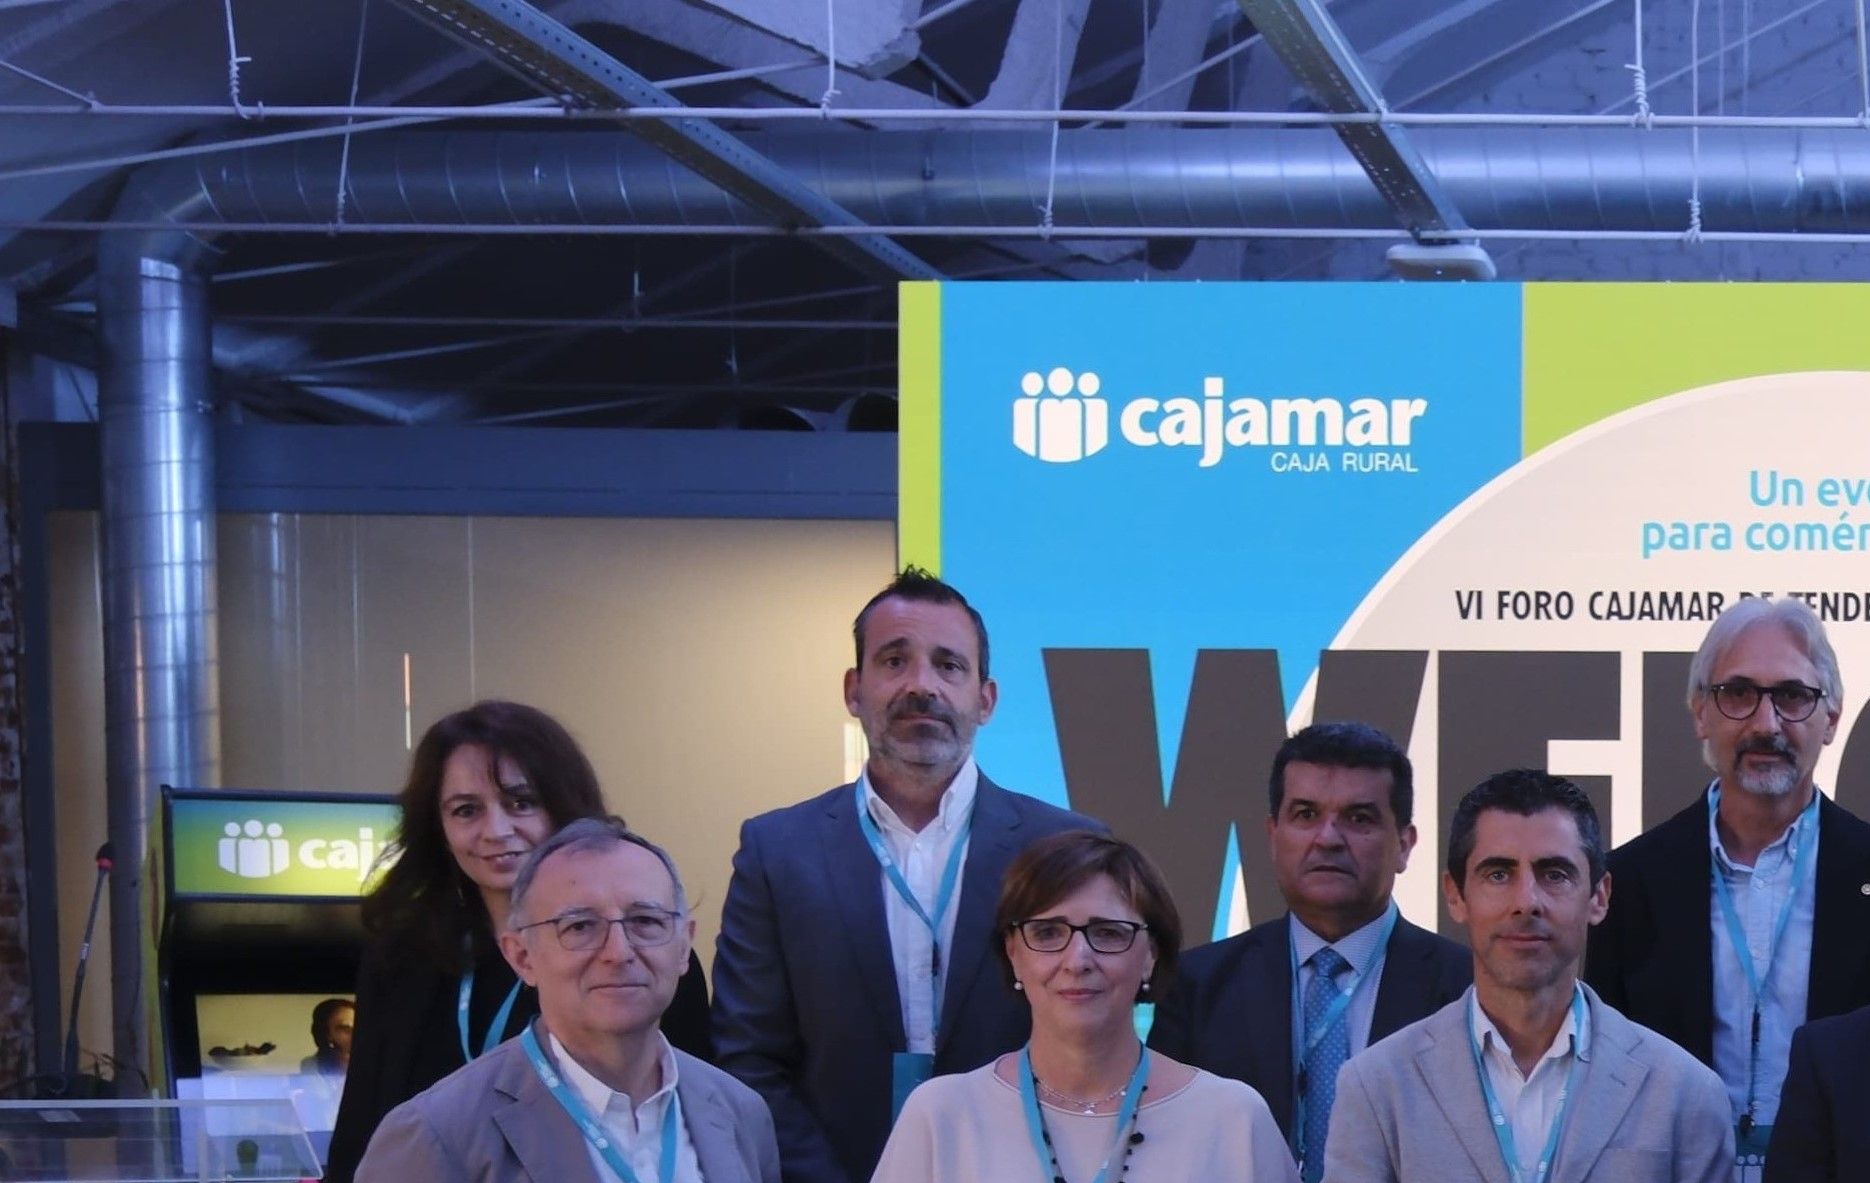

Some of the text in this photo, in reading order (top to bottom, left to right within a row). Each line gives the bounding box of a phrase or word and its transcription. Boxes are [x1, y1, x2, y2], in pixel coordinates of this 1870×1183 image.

[1119, 376, 1428, 468] cajamar
[1271, 452, 1419, 473] CAJA RURAL
[1750, 470, 1804, 507] Un
[1642, 521, 1733, 560] para
[1455, 589, 1483, 621] VI
[1498, 590, 1575, 621] FORO
[1588, 590, 1725, 622] CAJAMAR
